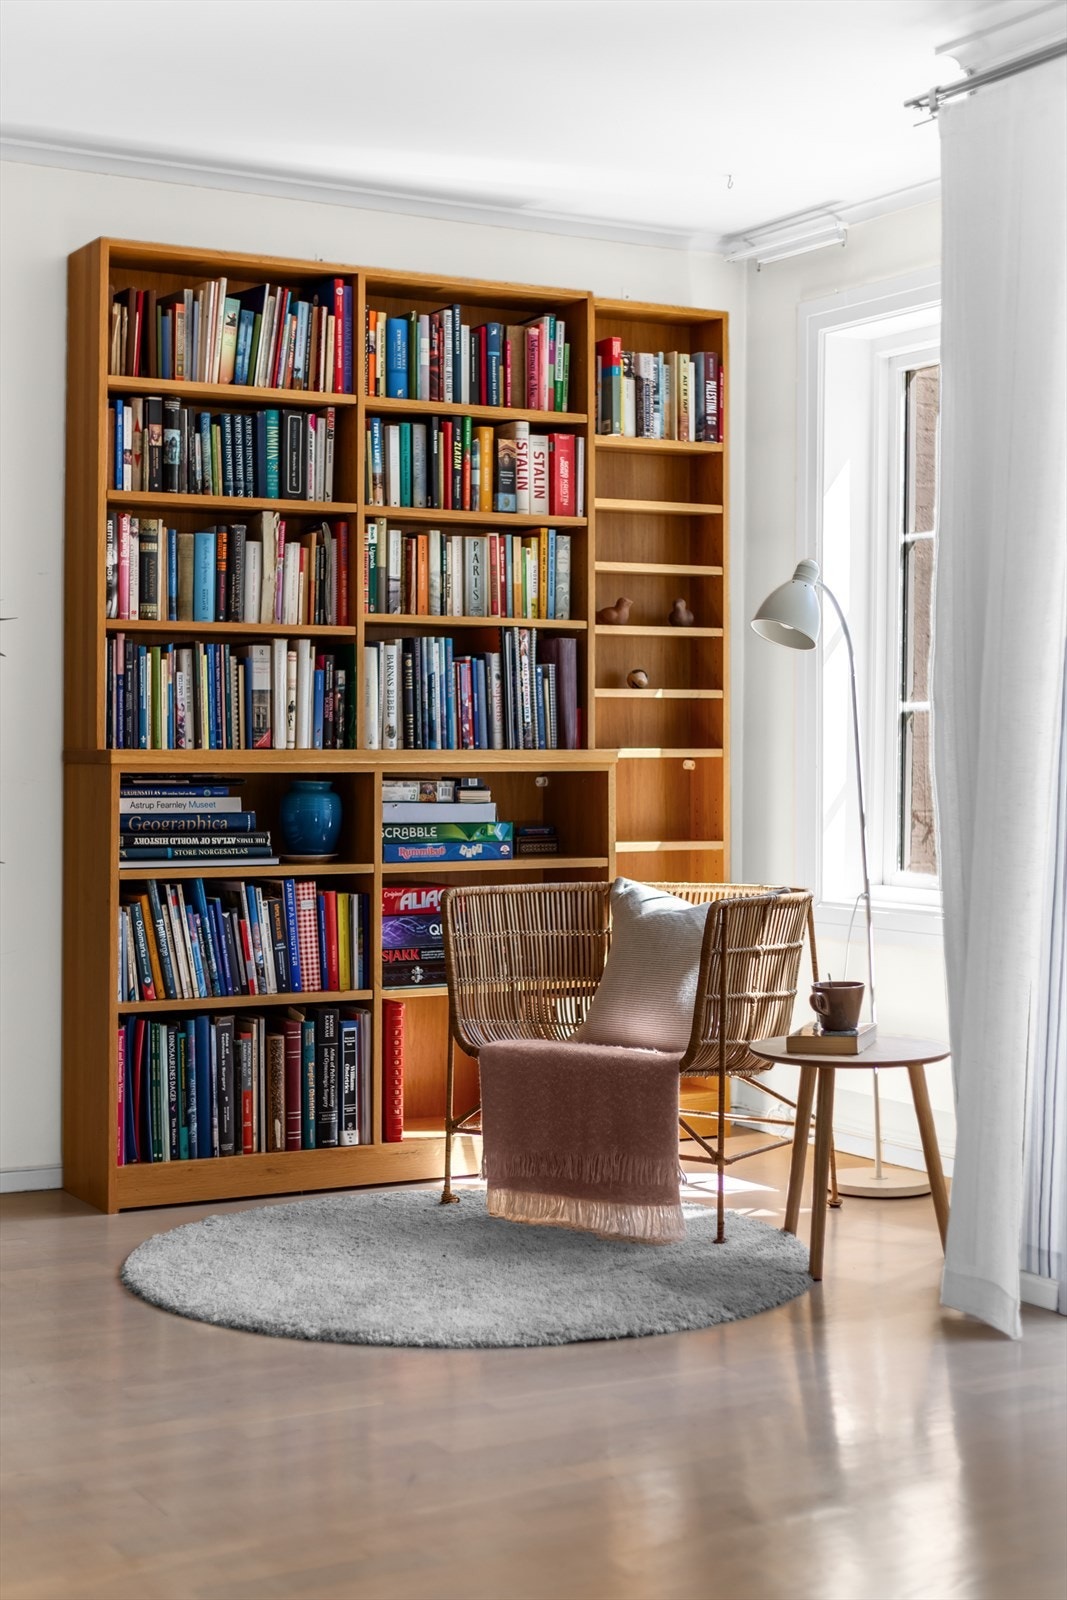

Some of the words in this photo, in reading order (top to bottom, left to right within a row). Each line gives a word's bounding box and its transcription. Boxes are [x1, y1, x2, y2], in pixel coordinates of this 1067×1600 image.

[706, 381, 717, 414] PALESTINA
[267, 426, 278, 460] IMMUN
[516, 442, 528, 490] STALIN
[534, 451, 545, 499] STALIN
[493, 683, 502, 722] Sapiens
[130, 800, 155, 810] Astrup
[156, 800, 187, 809] Fearnley
[188, 800, 216, 808] Museet
[128, 815, 228, 832] Geographica
[382, 826, 438, 839] SCRABBLE
[398, 846, 446, 859] Rummikub
[384, 890, 404, 899] Original
[288, 907, 295, 917] PÅ
[136, 920, 147, 958] Oslomarka
[156, 919, 168, 956] FjellNorge
[382, 949, 420, 963] SJAKK
